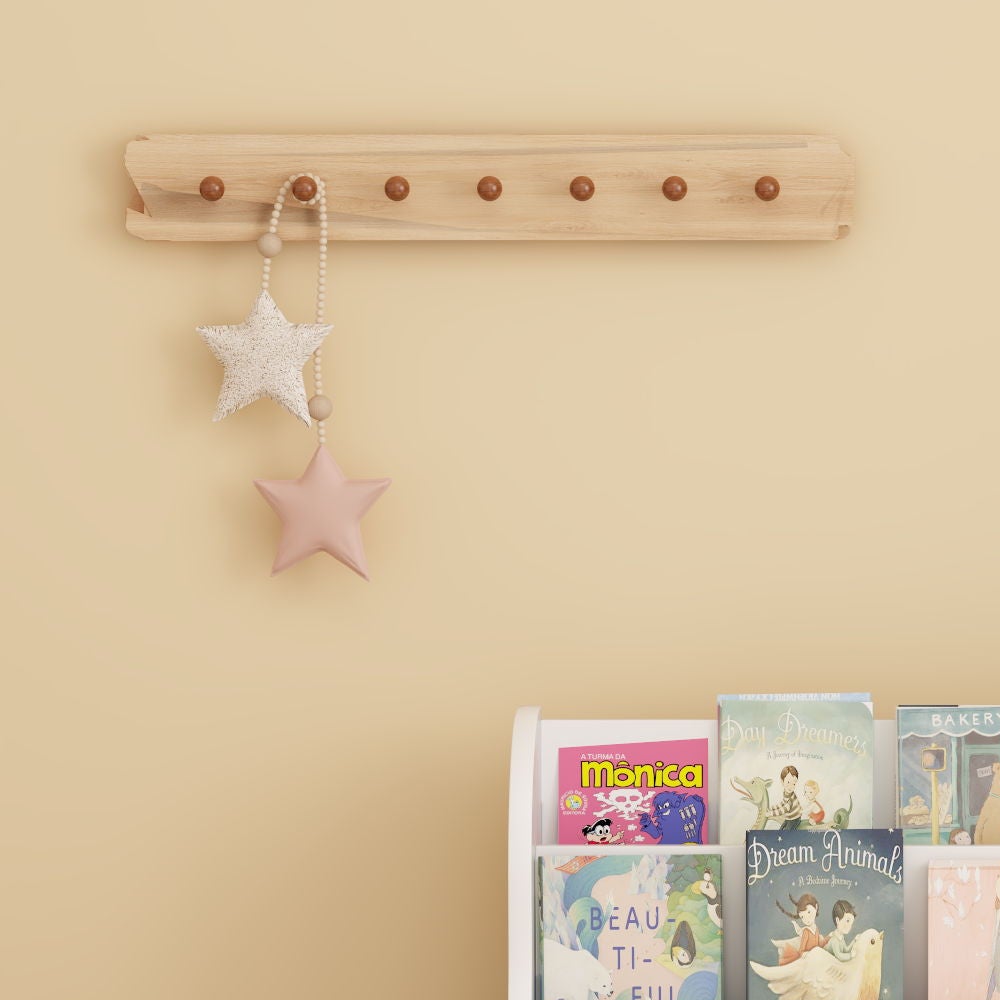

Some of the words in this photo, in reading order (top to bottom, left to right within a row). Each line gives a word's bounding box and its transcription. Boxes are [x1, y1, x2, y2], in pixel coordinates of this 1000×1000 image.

[720, 714, 766, 752] Day
[775, 706, 868, 757] Dreamers
[747, 836, 817, 886] Dream
[821, 829, 903, 884] Animals
[590, 906, 676, 932] BEAU-
[612, 946, 652, 970] TI-
